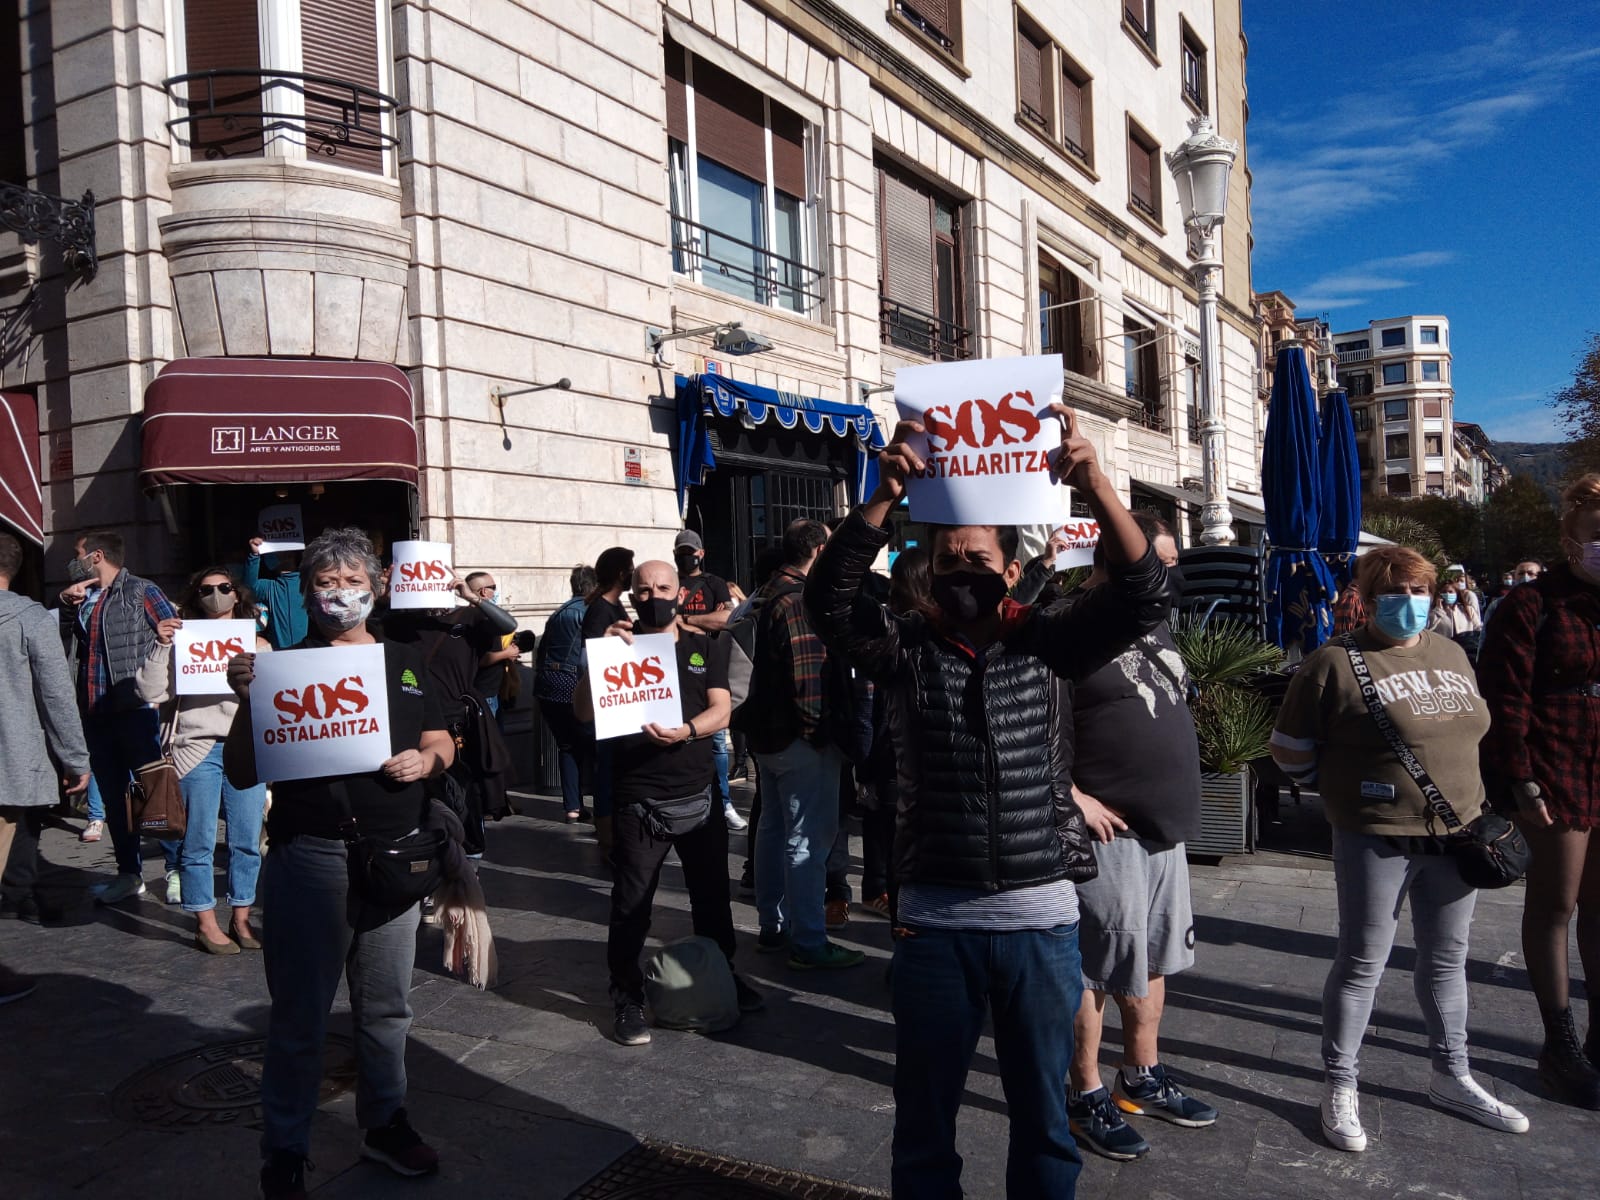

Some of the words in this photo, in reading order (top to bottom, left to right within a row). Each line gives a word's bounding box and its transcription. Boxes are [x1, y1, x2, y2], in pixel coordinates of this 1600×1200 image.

[250, 425, 340, 441] LANGER
[923, 389, 1041, 453] SOS
[280, 444, 341, 453] ANTIGÜEDADES
[263, 516, 296, 533] SOS
[400, 559, 446, 582] SOS
[188, 637, 245, 663] SOS
[182, 663, 229, 675] OSTALAR
[603, 655, 665, 693] SOS
[273, 675, 369, 725] SOS
[599, 686, 673, 709] OSTALARITZA
[1374, 670, 1433, 705] NEW
[1405, 687, 1474, 715] 1981
[263, 717, 379, 745] OSTALARITZA
